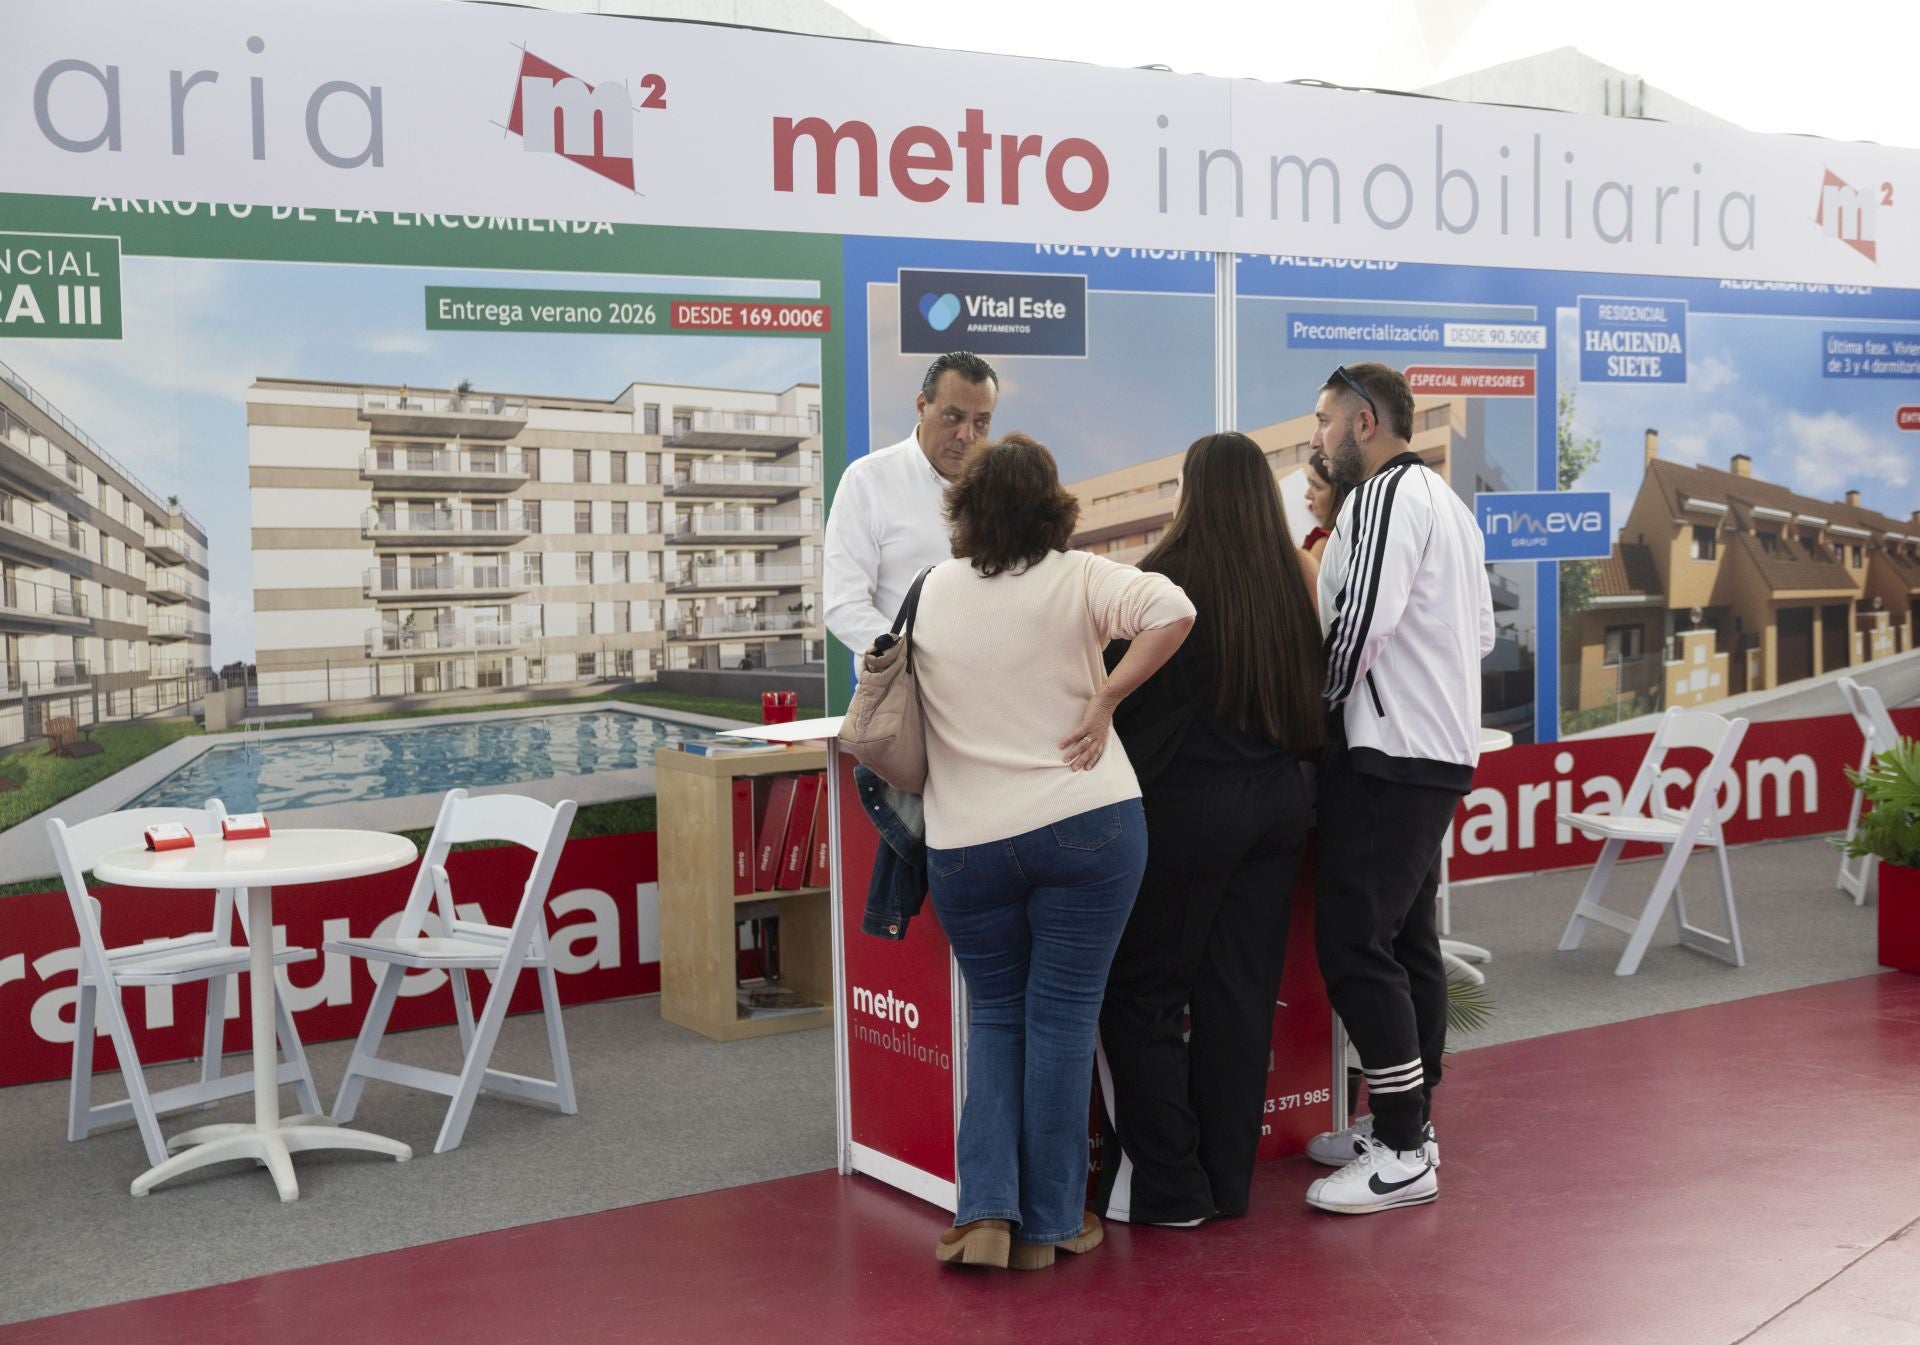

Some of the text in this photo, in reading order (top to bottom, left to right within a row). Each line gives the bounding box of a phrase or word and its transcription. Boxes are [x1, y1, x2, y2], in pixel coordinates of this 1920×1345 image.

[773, 108, 1756, 252] metro inmobiliaria
[0, 284, 102, 325] A III
[439, 298, 823, 328] Entrega verano 2026 DESDE 169.000€
[965, 295, 1067, 320] Vital Este
[1598, 304, 1669, 323] RESIDENCIAL
[967, 323, 1031, 334] APARTAMENTOS
[1294, 320, 1541, 345] Precomercialización DESDE 90.500€
[1585, 330, 1683, 354] HACIENDA
[1607, 355, 1663, 378] SIETE
[1410, 374, 1526, 389] ESPECIAL INVERSORES
[1511, 538, 1548, 547] GRUPO
[760, 846, 771, 871] metro
[789, 846, 799, 871] metro
[819, 843, 827, 868] metro
[853, 985, 919, 1029] metro
[854, 1017, 950, 1070] inmobiliaria
[1278, 1093, 1300, 1111] 371
[1304, 1088, 1330, 1106] 985
